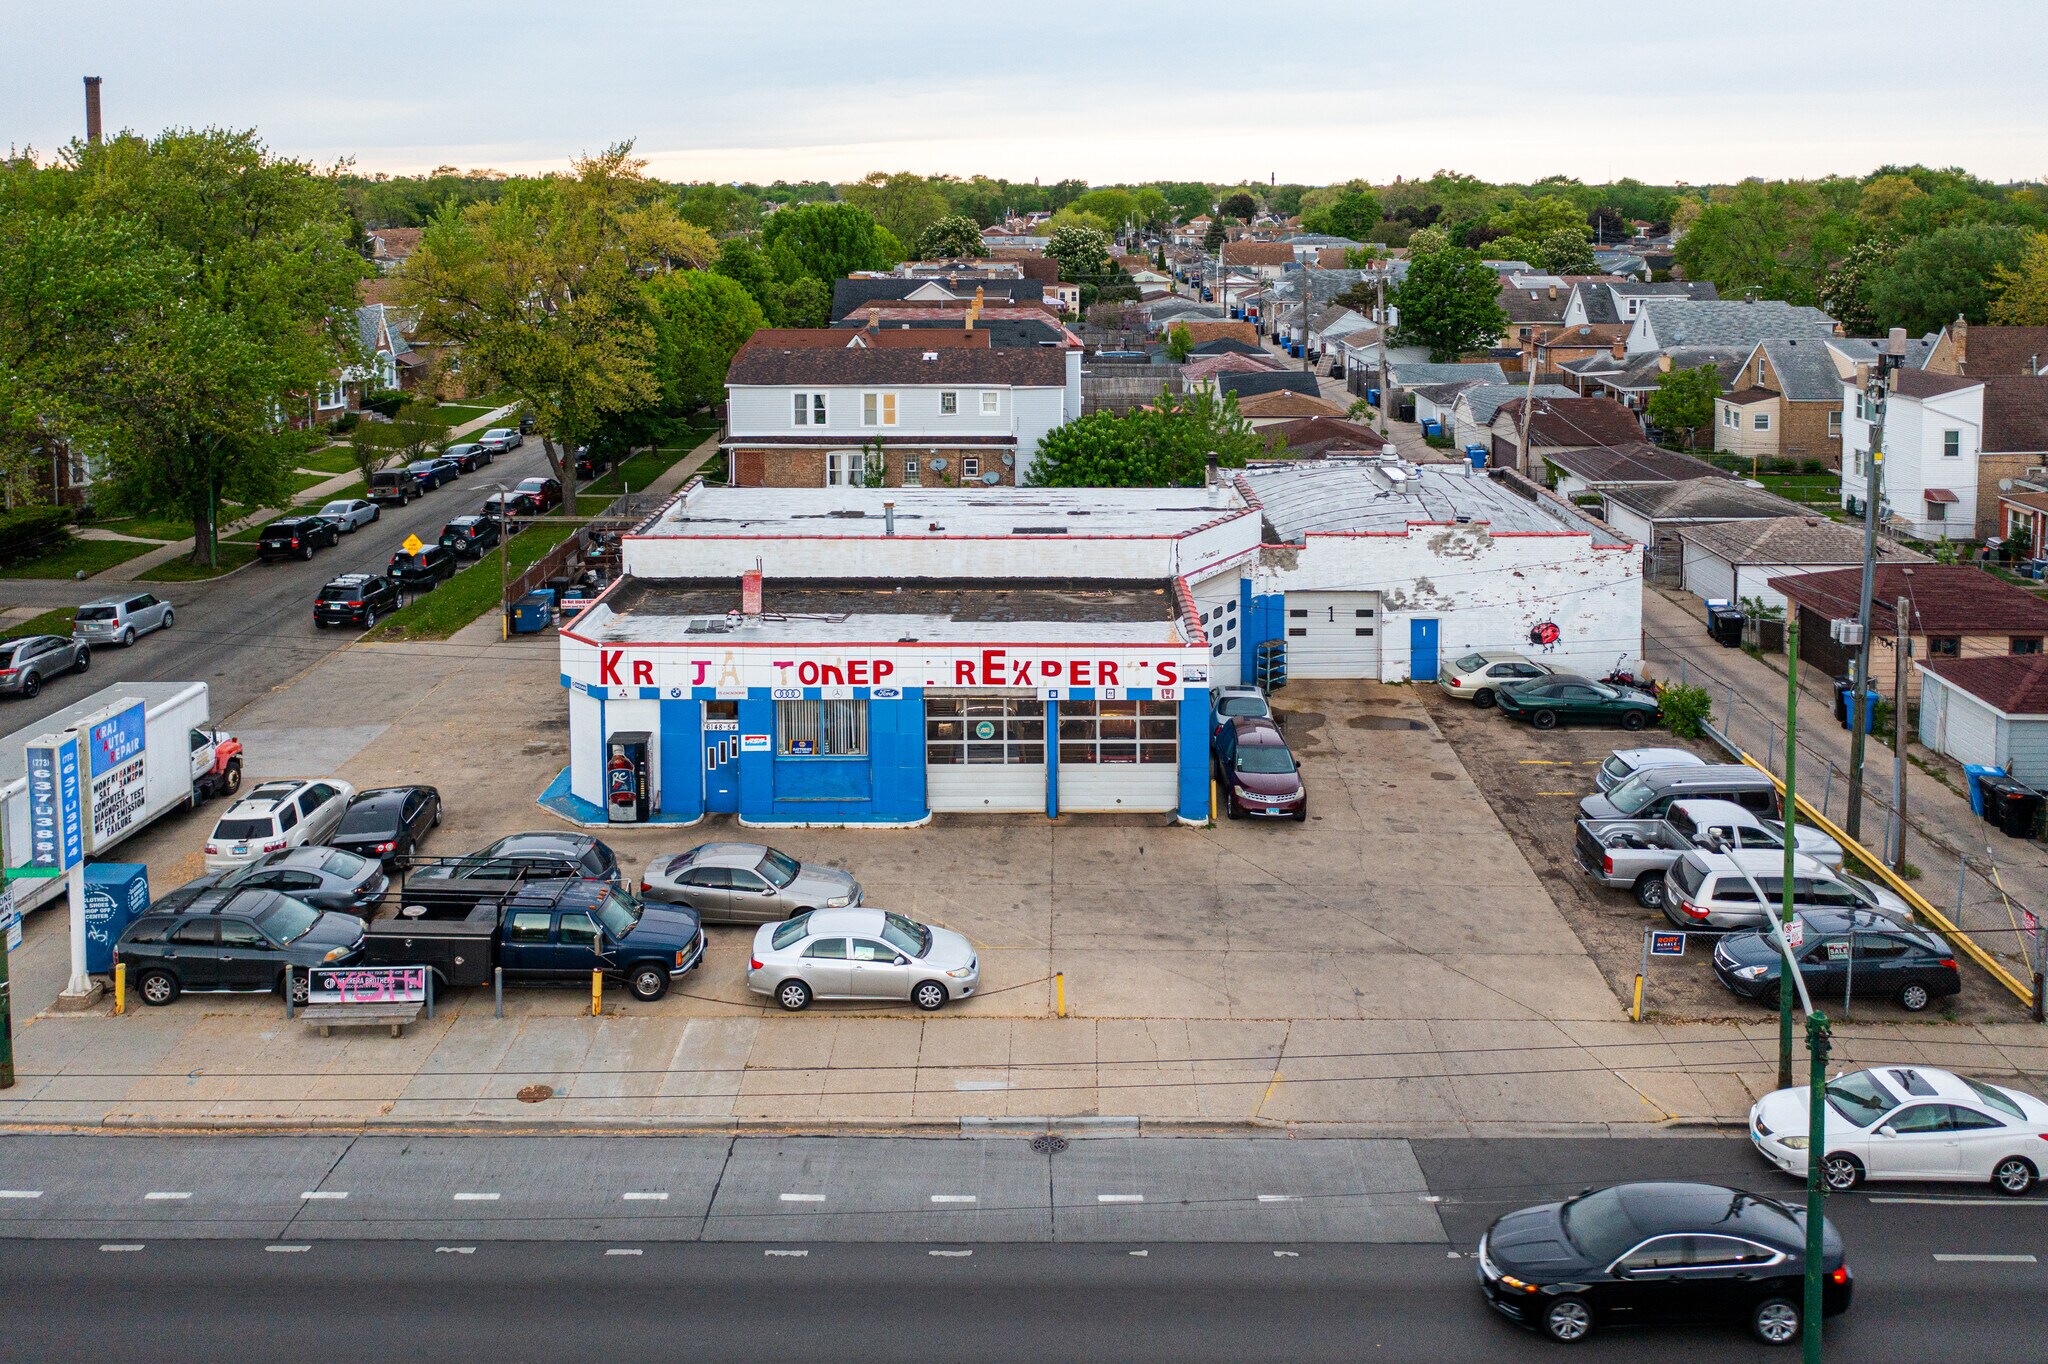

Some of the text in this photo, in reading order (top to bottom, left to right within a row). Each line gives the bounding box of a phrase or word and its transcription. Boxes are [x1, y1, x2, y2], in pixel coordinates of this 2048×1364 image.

[1328, 605, 1335, 622] 1
[1422, 626, 1426, 637] 1
[95, 720, 117, 741] KRAJ
[102, 731, 125, 752] AUTO
[110, 737, 140, 763] REPAIR
[612, 772, 628, 786] RC
[94, 788, 125, 813] COMPUTER
[99, 787, 110, 800] SAT
[94, 787, 144, 824] DIAGNOSTIC TEST
[95, 796, 145, 834] WE FIX EMISSION
[106, 814, 132, 837] FAILURE
